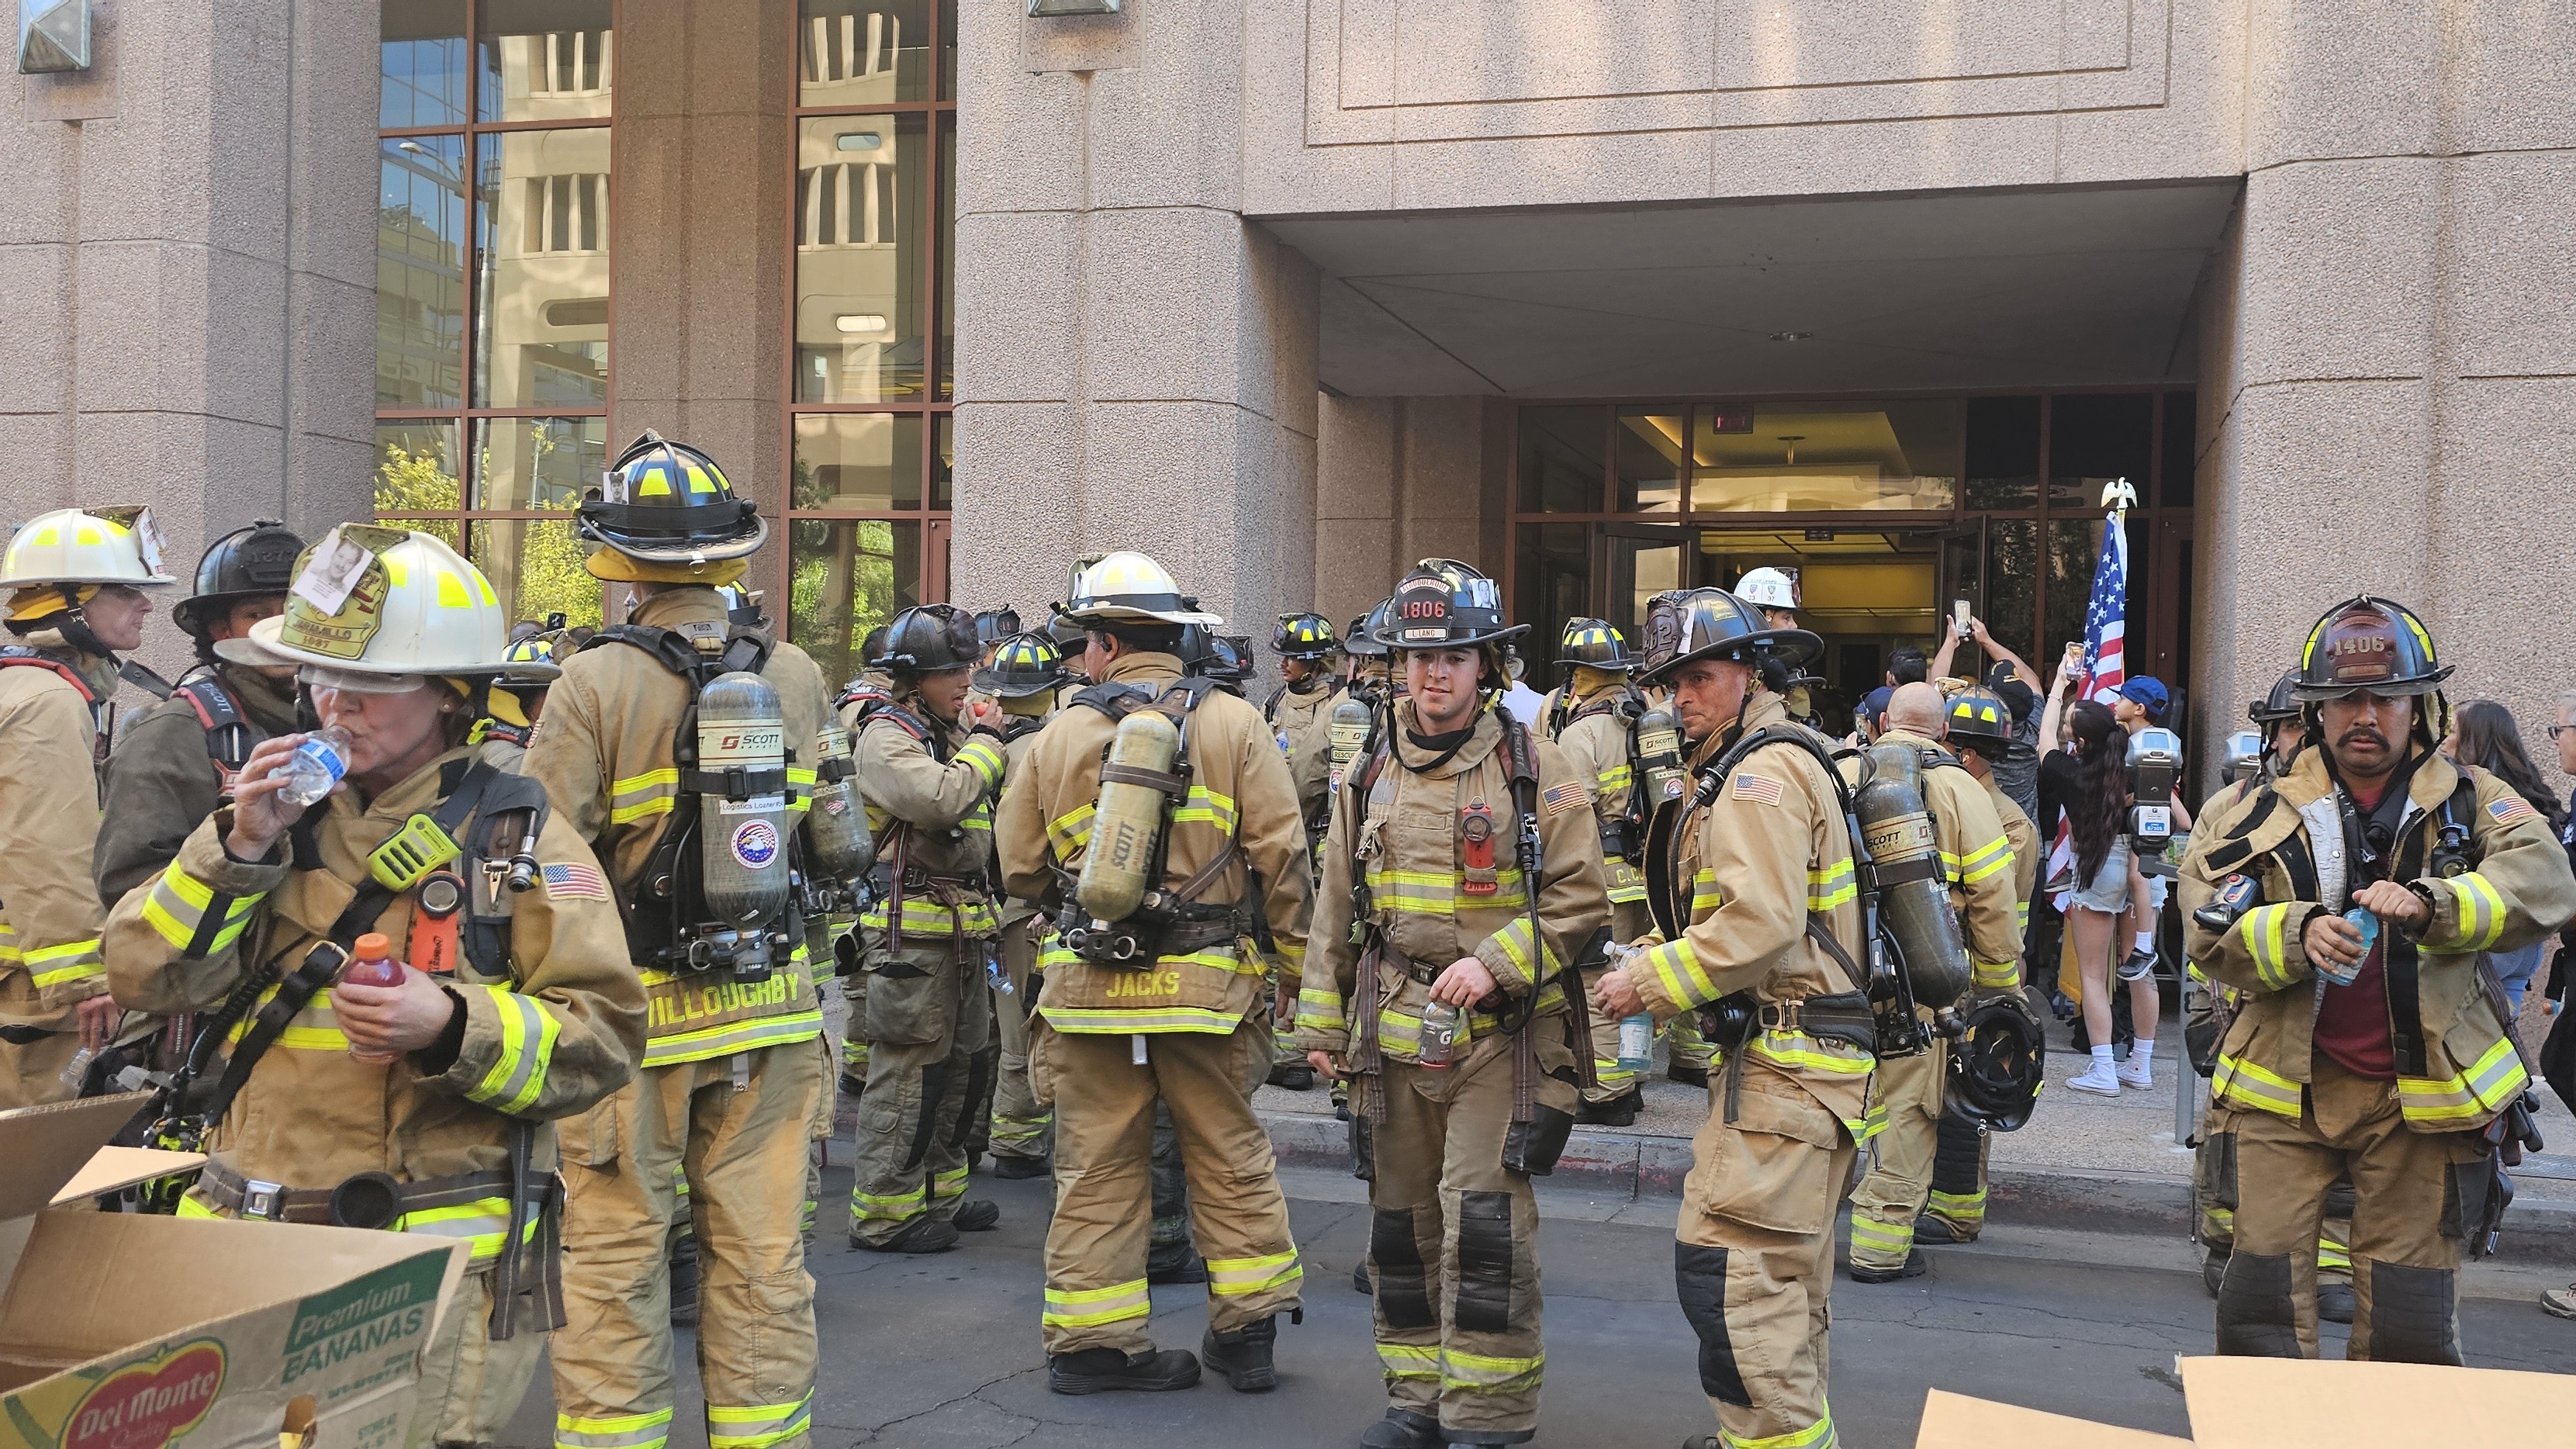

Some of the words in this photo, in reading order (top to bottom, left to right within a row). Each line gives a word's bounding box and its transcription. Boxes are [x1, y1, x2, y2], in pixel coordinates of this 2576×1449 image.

[1402, 579, 1448, 593] ALBUQUERQUE
[1403, 600, 1445, 619] 1806
[2334, 635, 2384, 656] 1406
[742, 734, 780, 744] SCOTT
[722, 801, 752, 811] Logistics
[1111, 821, 1136, 870] SCOTT
[1867, 831, 1901, 848] SCOTT
[1105, 971, 1180, 998] JACKS
[648, 972, 799, 1028] ILLOUGHBY
[295, 1281, 411, 1345] Premium
[280, 1308, 424, 1385] BANANAS
[78, 1398, 125, 1441] Del
[129, 1370, 216, 1423] Monte
